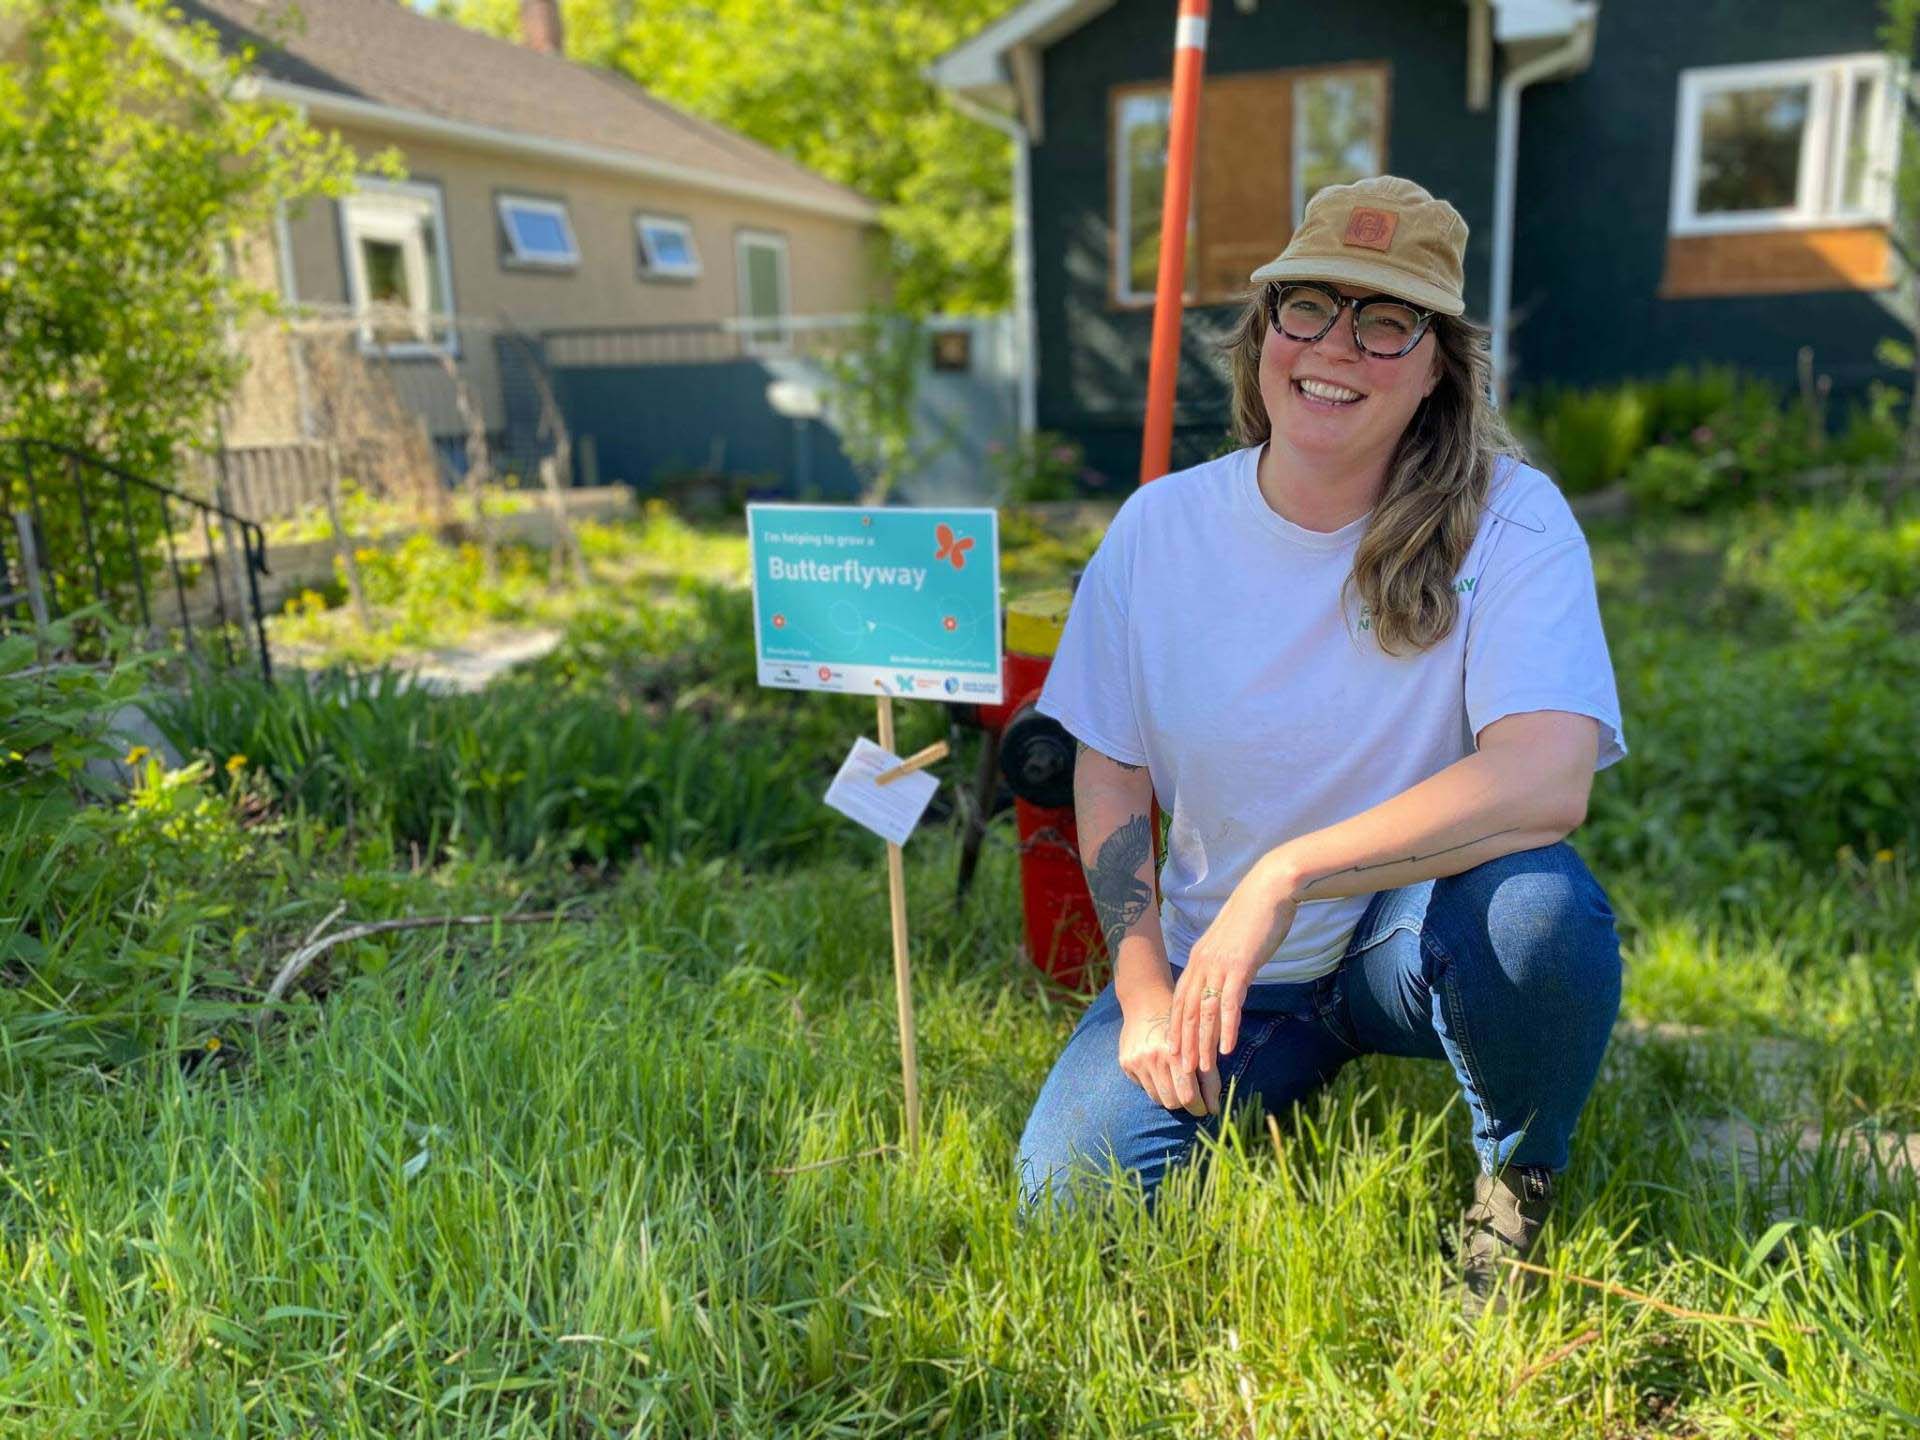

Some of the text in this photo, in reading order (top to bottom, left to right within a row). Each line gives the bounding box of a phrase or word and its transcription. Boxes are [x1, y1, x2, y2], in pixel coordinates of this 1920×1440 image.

[782, 532, 821, 547] helping
[823, 533, 835, 545] to
[838, 536, 864, 548] grow
[769, 556, 928, 590] Butterflyway
